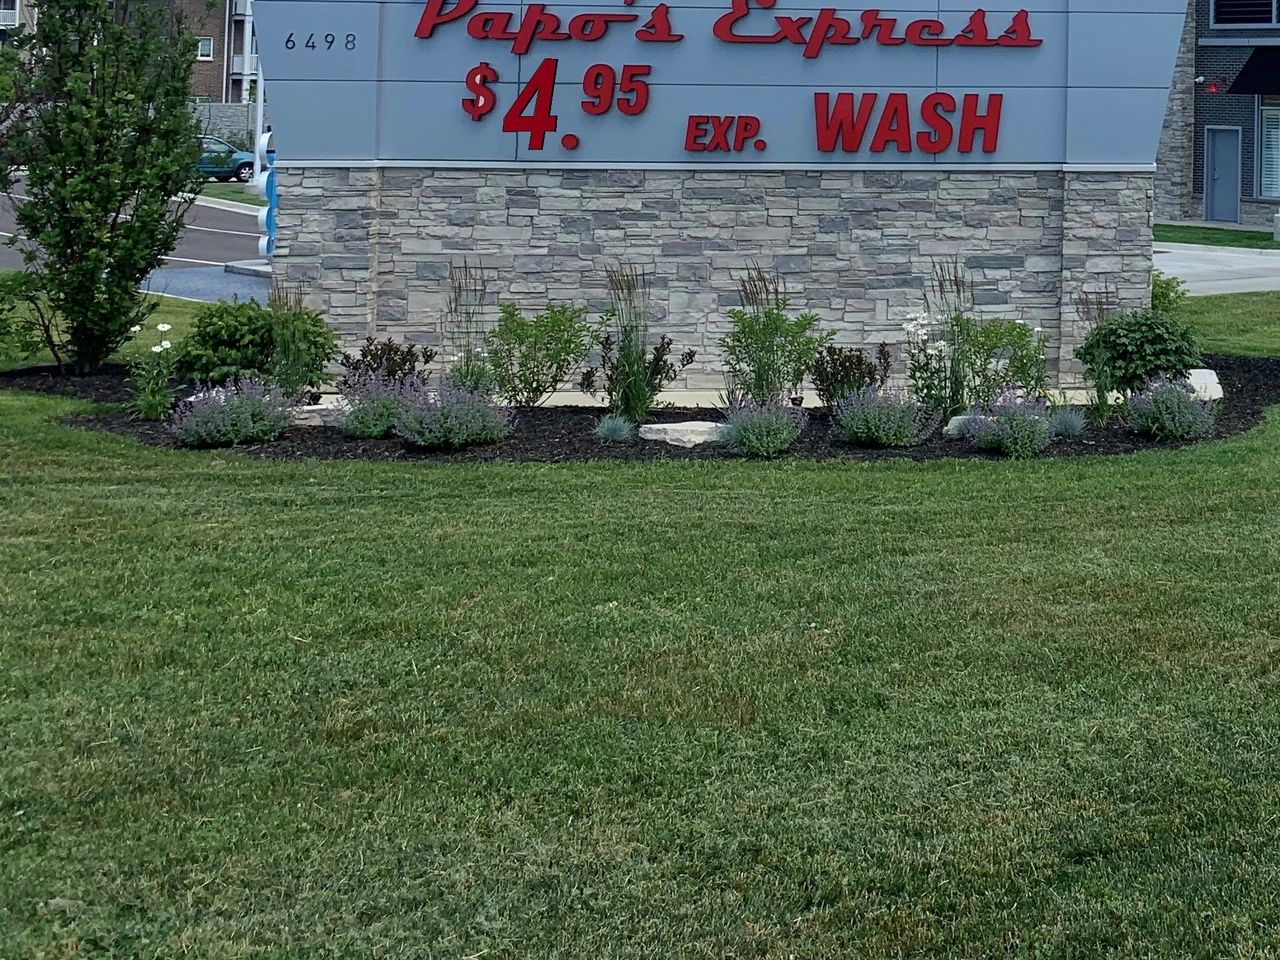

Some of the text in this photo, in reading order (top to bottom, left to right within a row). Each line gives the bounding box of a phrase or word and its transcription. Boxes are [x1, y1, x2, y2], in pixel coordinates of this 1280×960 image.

[285, 32, 356, 51] 6498
[684, 115, 768, 152] EXP.
[814, 92, 1004, 154] WASH
